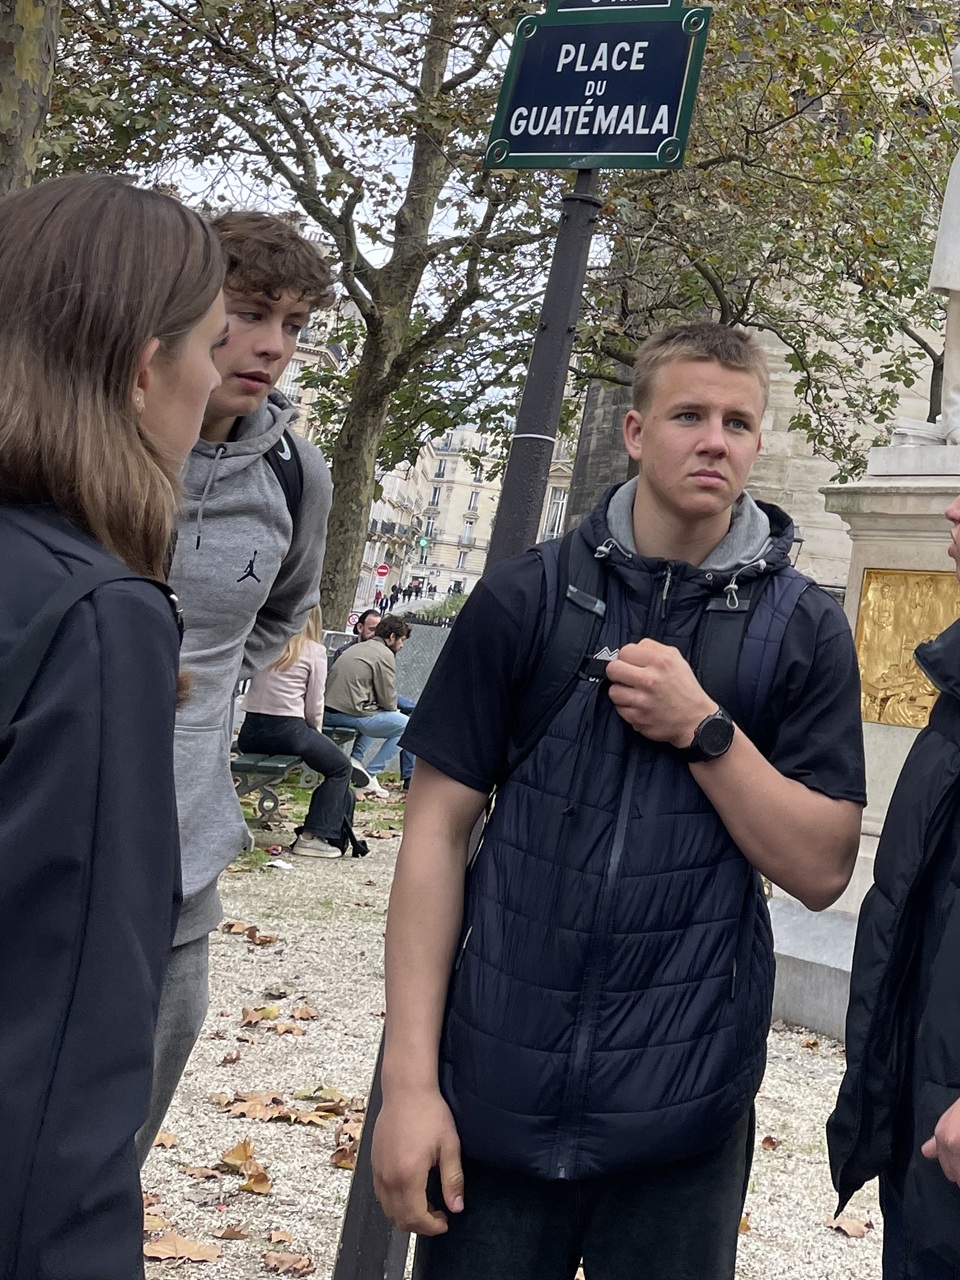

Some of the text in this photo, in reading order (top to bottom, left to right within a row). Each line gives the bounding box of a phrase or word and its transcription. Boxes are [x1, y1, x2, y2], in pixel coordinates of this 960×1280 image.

[556, 41, 649, 73] PLACE
[584, 80, 607, 97] DU
[509, 98, 669, 136] GUATÉMALA
